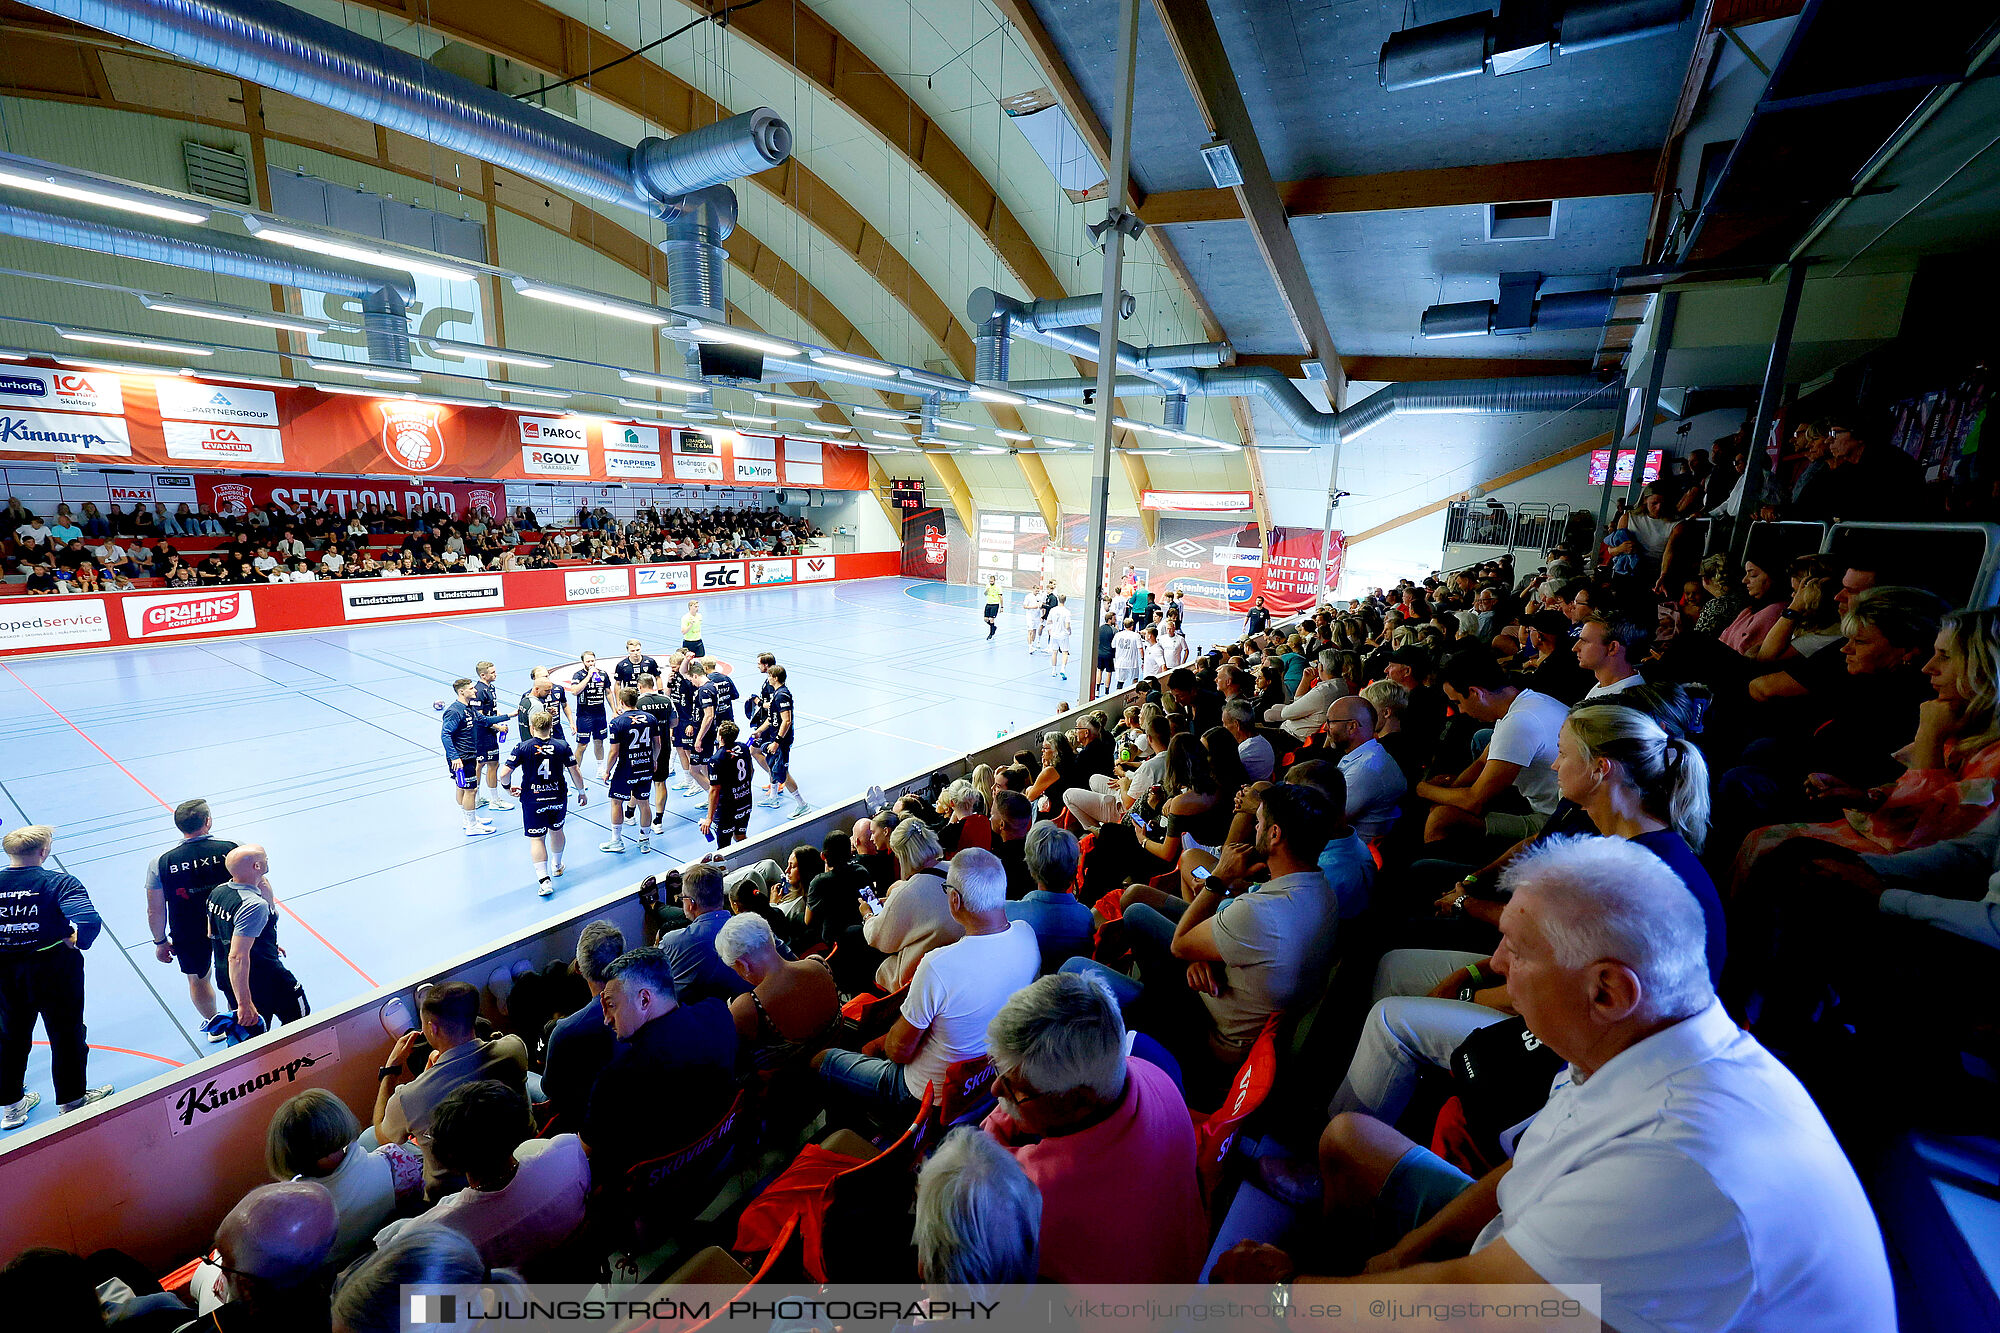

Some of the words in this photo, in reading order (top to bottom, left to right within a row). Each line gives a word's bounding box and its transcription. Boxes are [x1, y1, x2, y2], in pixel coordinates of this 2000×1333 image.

[53, 374, 96, 393] ICA
[60, 398, 97, 407] Skultorp
[0, 416, 120, 448] Kinnarps
[210, 428, 241, 442] ICA
[543, 428, 581, 439] PAROC
[203, 442, 251, 451] KVANTUM
[407, 460, 427, 469] 1949
[1166, 560, 1201, 569] umbro
[1268, 555, 1298, 567] MITT
[1299, 558, 1322, 569] SKÖV
[660, 570, 688, 580] zerva
[703, 566, 739, 586] stc
[1267, 568, 1297, 580] MITT
[1298, 571, 1315, 581] LAG
[438, 589, 483, 599] Lindströms
[484, 588, 494, 596] Bil
[1266, 580, 1295, 593] MITT
[1297, 583, 1330, 595] HJÄRA
[355, 595, 405, 606] Lindströms
[407, 592, 419, 601] Bil
[149, 597, 236, 624] GRAHNS
[167, 615, 218, 628] KONFEKTYR
[641, 703, 669, 711] BRIXLY
[628, 726, 651, 750] 24
[537, 758, 551, 780] 4
[736, 758, 747, 781] 8
[175, 1051, 332, 1126] Kinnarps
